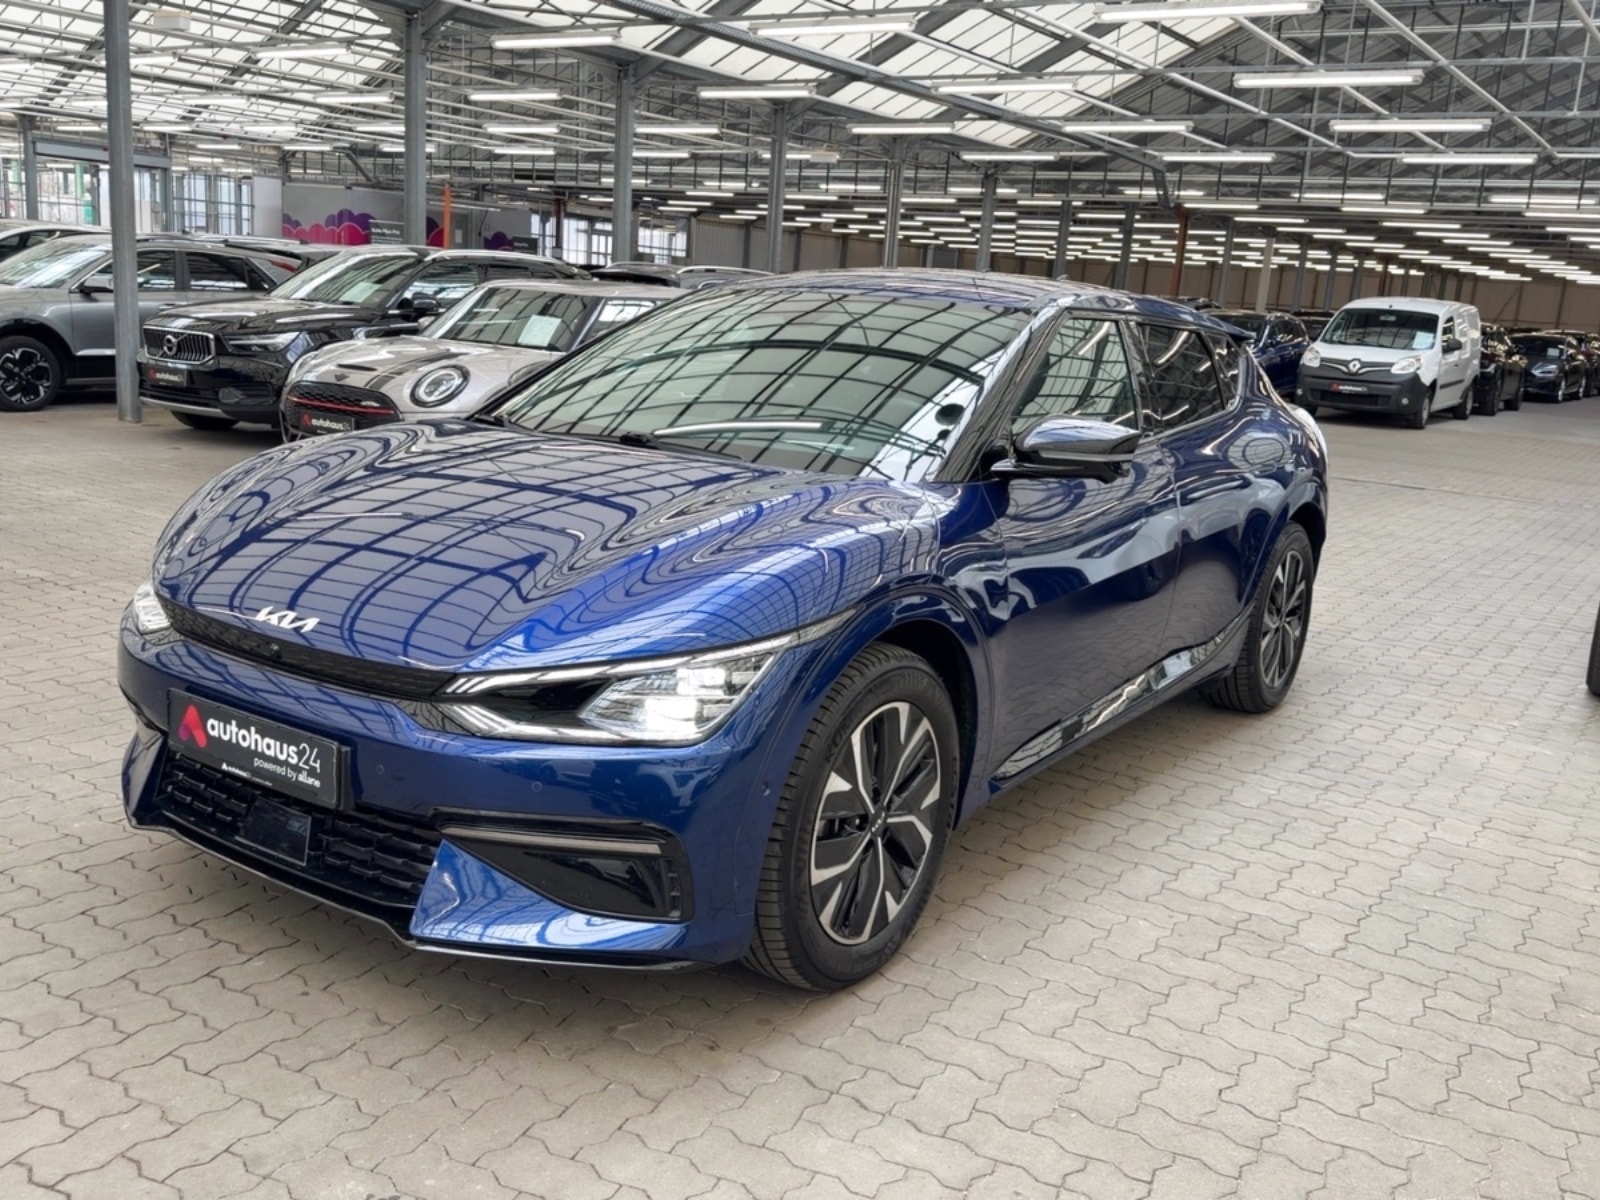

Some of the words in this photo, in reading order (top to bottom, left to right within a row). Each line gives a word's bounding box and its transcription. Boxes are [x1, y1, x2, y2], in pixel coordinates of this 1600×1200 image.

[255, 605, 320, 633] KIA
[206, 718, 321, 774] autohaus24
[253, 757, 286, 776] powered
[287, 766, 297, 781] by
[297, 770, 321, 788] allane
